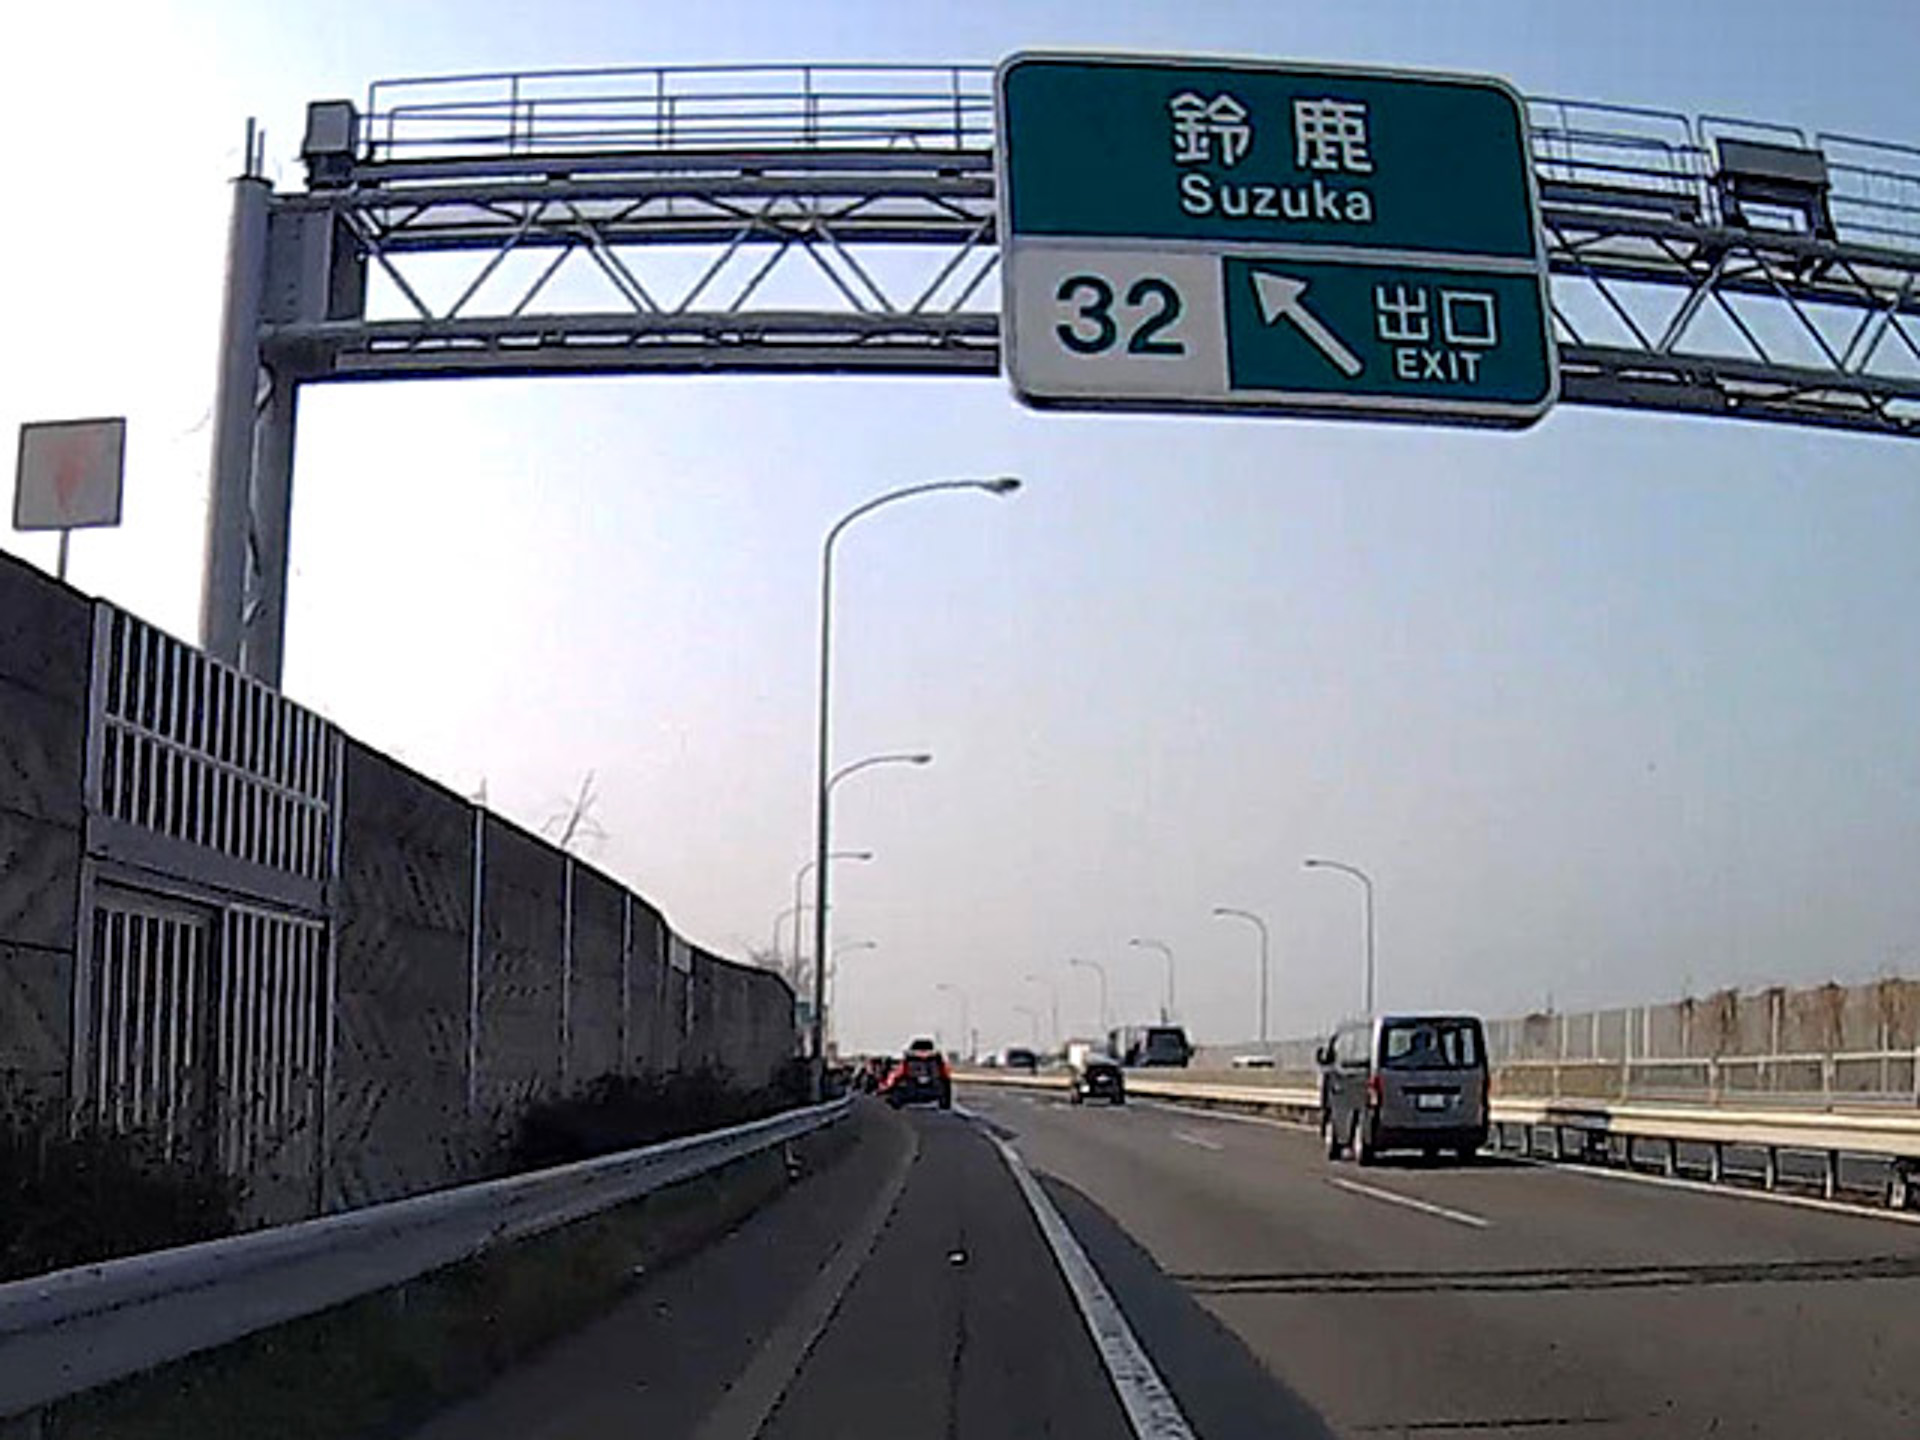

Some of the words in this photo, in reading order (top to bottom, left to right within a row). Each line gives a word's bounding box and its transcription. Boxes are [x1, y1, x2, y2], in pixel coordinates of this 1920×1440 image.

[1172, 92, 1373, 172] 鈴鹿
[1181, 174, 1373, 222] Suzuka
[1056, 276, 1186, 355] 32
[1376, 284, 1498, 346] 出口
[1397, 349, 1482, 382] EXIT
